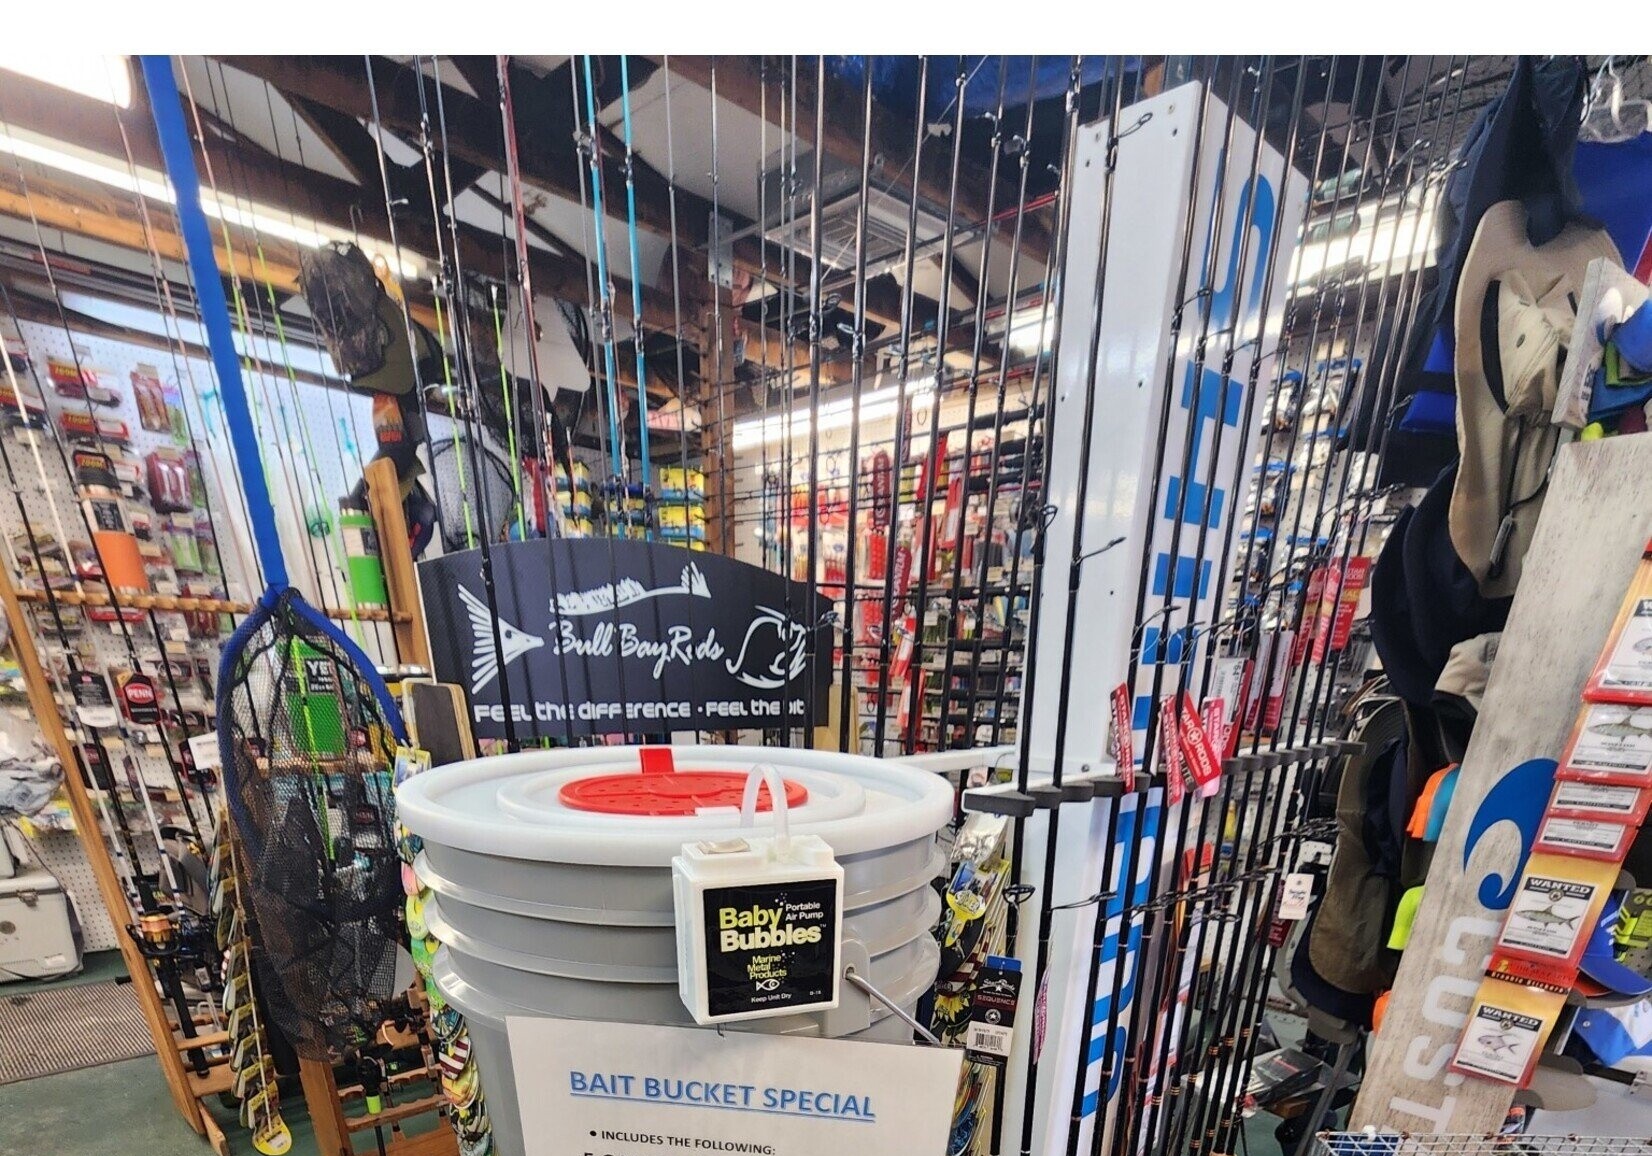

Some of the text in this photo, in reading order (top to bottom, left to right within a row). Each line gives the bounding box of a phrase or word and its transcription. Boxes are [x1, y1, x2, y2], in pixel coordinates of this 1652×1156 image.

[549, 619, 614, 655] Bull
[619, 622, 671, 680] Bay
[473, 702, 532, 722] FEEL
[706, 701, 748, 717] FEEL
[1194, 741, 1212, 776] RODS
[1529, 878, 1592, 894] WANTED
[719, 901, 821, 930] Baby Portable
[785, 911, 824, 921] Air Pump
[747, 963, 771, 973] Metal
[752, 955, 781, 964] Marine
[750, 969, 787, 979] Products
[1482, 1006, 1539, 1027] WANTED
[569, 1071, 876, 1118] BAIT BUCKET SPECIAL
[601, 1130, 776, 1156] INCLUDES THE FOLLOWING:
